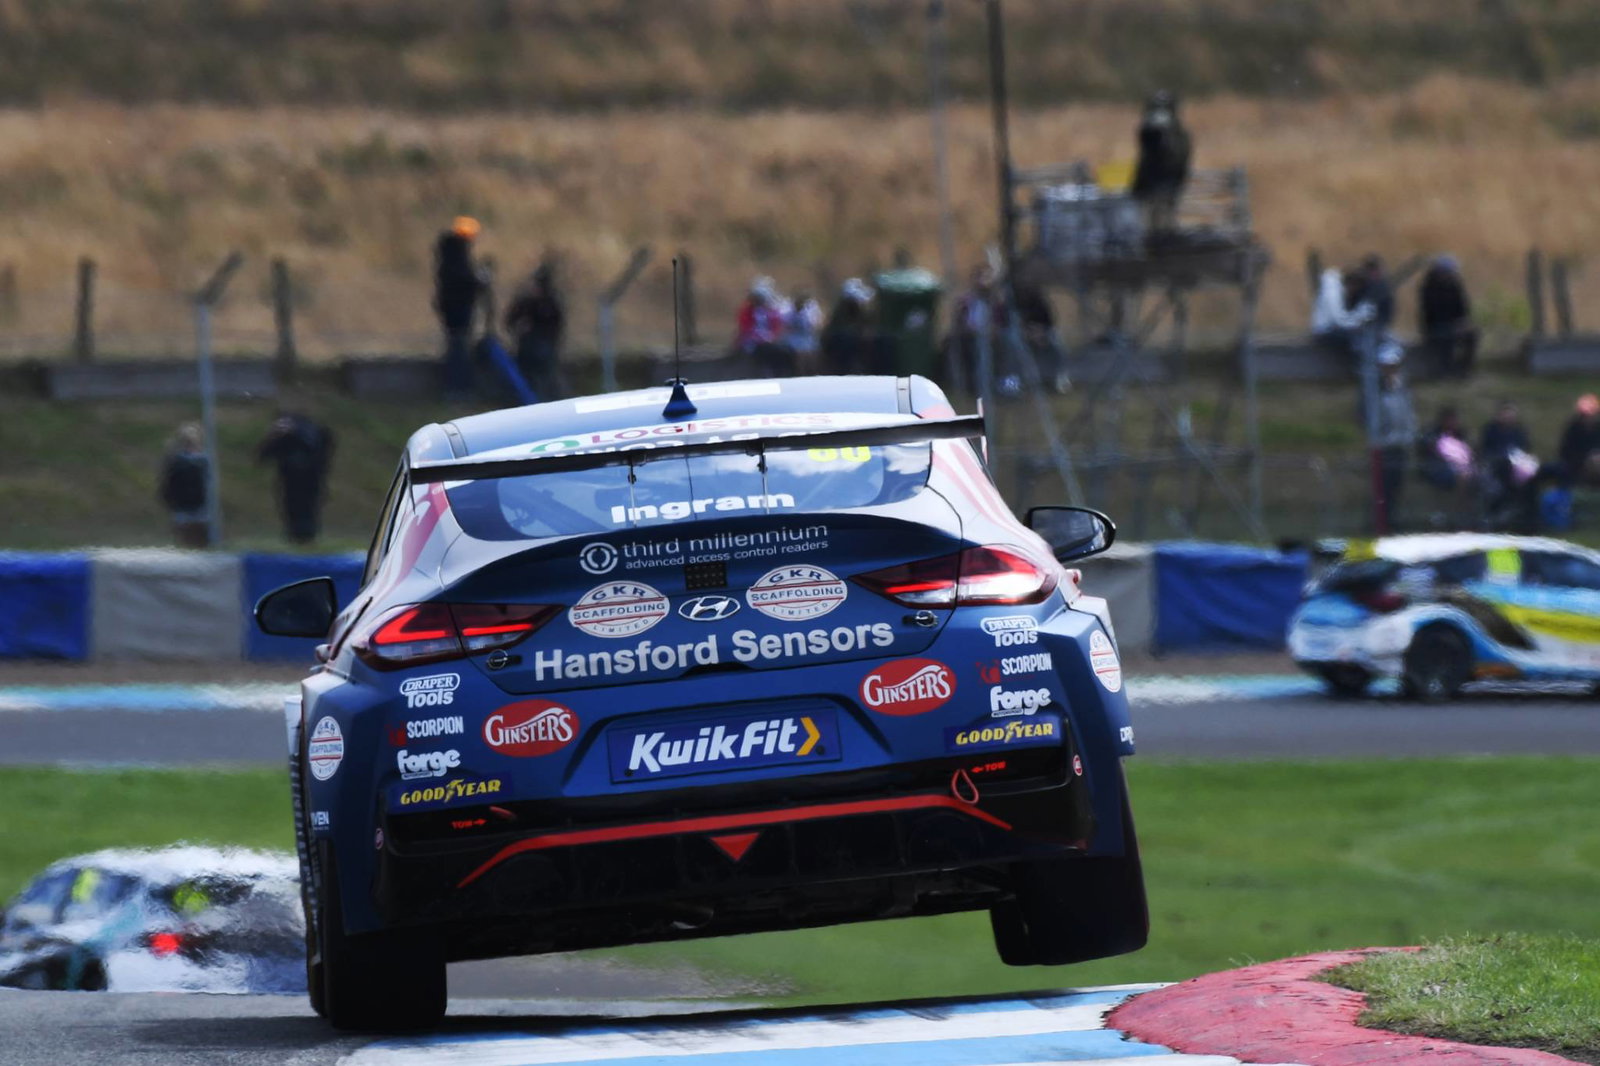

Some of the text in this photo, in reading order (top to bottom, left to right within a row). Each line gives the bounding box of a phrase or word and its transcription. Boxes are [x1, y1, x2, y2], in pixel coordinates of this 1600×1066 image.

[611, 492, 795, 523] Ingram
[622, 525, 828, 558] third millennium
[625, 540, 829, 570] advanced access control readers
[769, 570, 822, 583] GKR
[591, 586, 646, 601] GKR
[751, 586, 844, 601] SCAFFOLDING
[573, 602, 666, 620] SCAFFOLDING
[986, 618, 1036, 632] DRAPER
[992, 629, 1039, 648] Tools
[535, 622, 894, 681] Hansford Sensors
[1001, 652, 1053, 675] SCORPION
[403, 676, 454, 692] DRAPER
[407, 690, 454, 708] Tools
[406, 716, 464, 739] SCORPION
